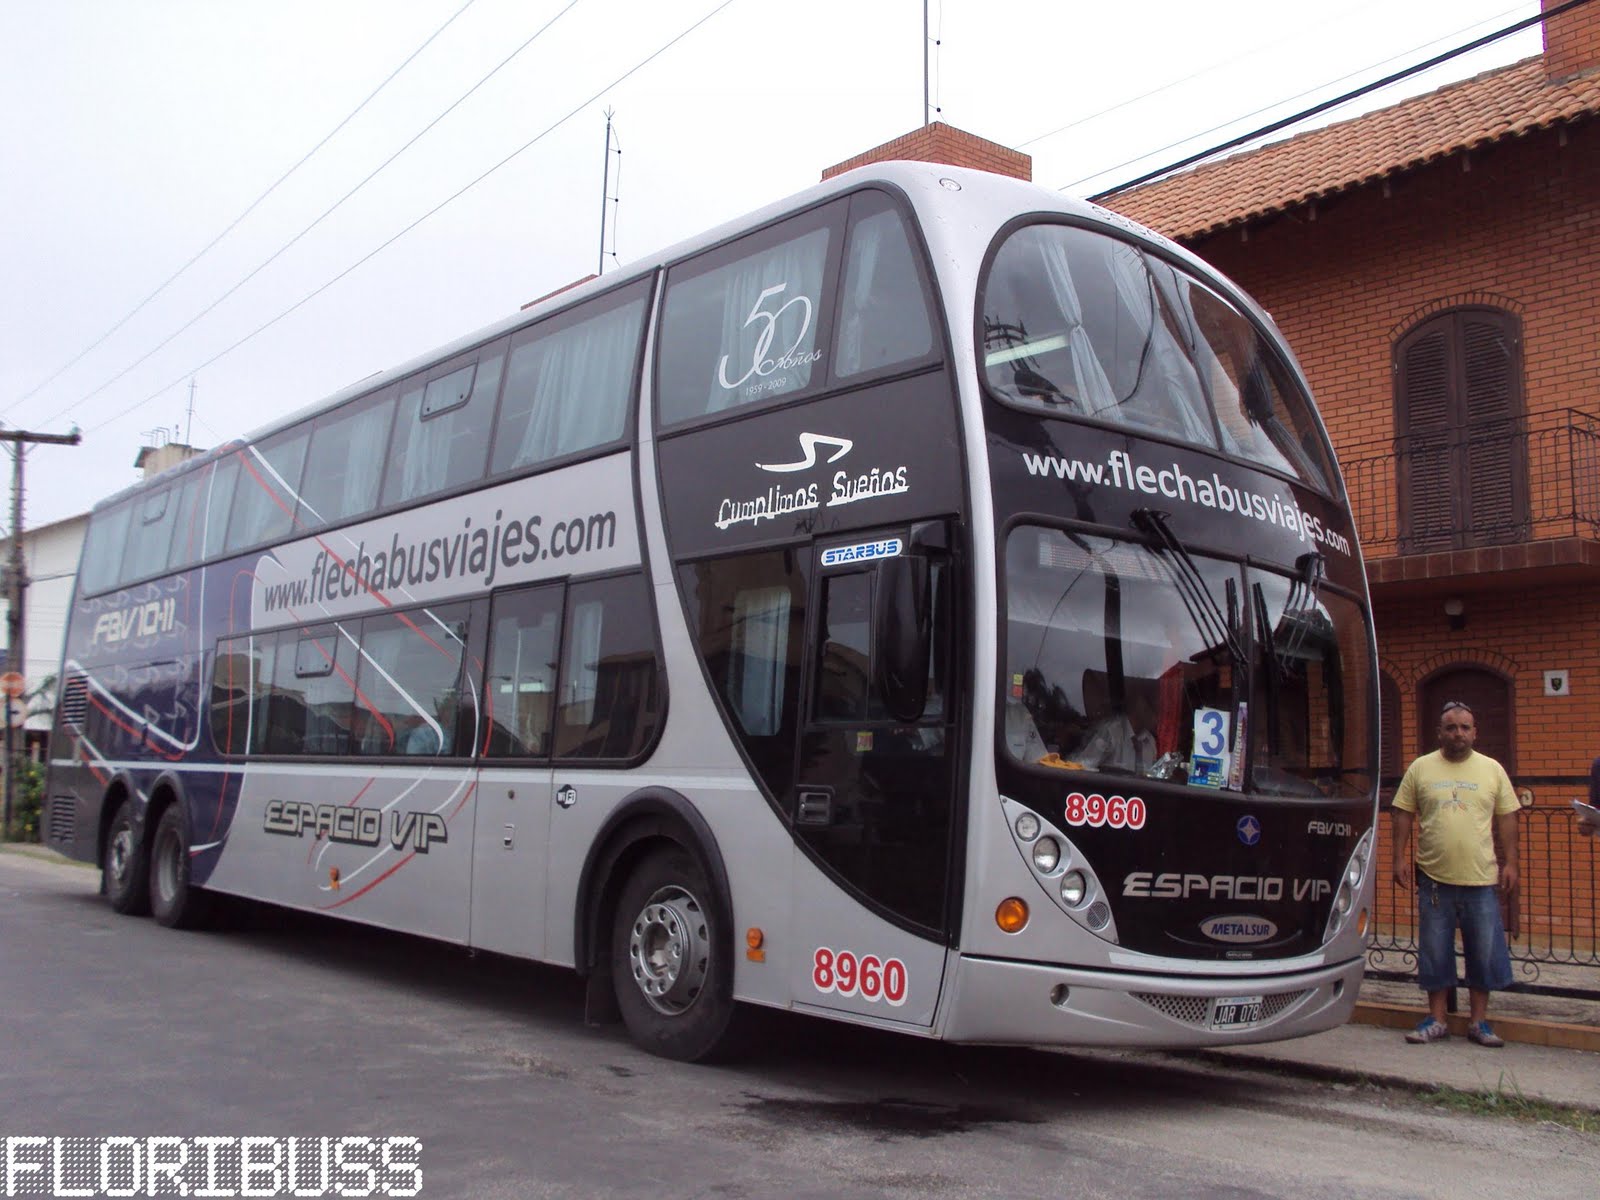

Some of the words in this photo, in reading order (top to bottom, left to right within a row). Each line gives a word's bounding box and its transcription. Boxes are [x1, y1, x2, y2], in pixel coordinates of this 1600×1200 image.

[827, 466, 910, 507] Sueños
[1022, 450, 1352, 557] www.flechabusviajes.com
[263, 509, 617, 612] www.flechabusviajes.com
[825, 541, 898, 564] STARBUS
[1201, 711, 1225, 756] 3
[263, 800, 382, 847] ESPACIO
[390, 810, 448, 853] VIP
[1065, 793, 1147, 829] 8960
[1122, 872, 1282, 901] ESPACIO
[1291, 879, 1332, 902] VIP
[1211, 922, 1270, 937] METALSUR
[812, 947, 909, 1006] 8960
[1214, 1006, 1237, 1024] JAR
